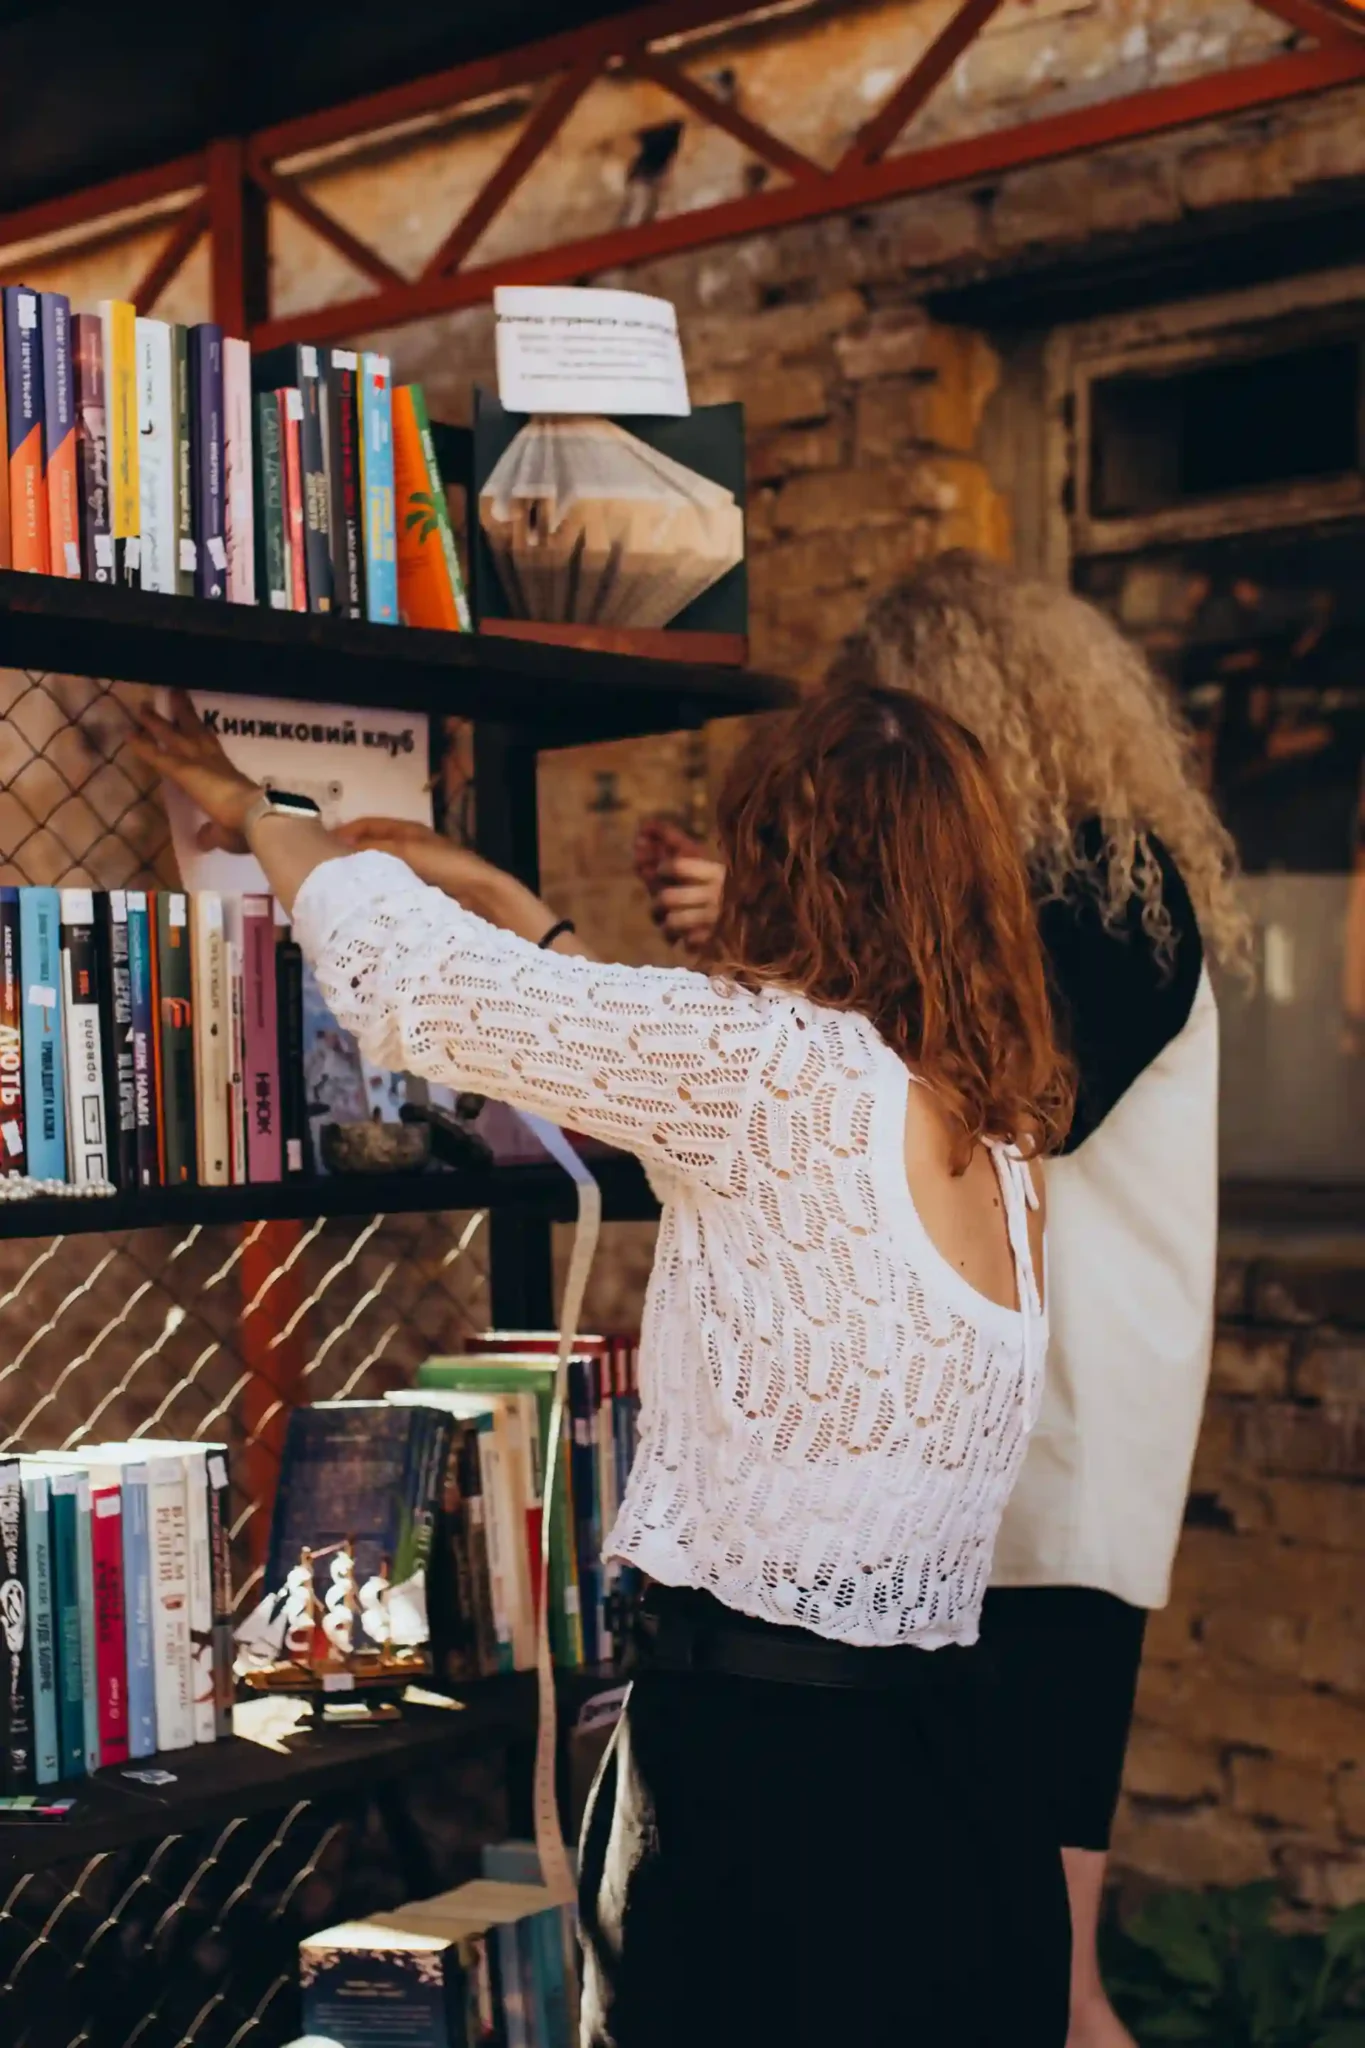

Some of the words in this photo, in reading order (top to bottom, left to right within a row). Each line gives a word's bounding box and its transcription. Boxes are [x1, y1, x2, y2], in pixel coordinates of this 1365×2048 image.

[203, 709, 357, 746] Книжковий
[363, 728, 415, 757] клуб
[0, 1023, 21, 1106] ЛЮТЬ
[83, 1019, 96, 1082] орвелл
[135, 1032, 146, 1069] МІЖ
[136, 1073, 149, 1126] НАМИ
